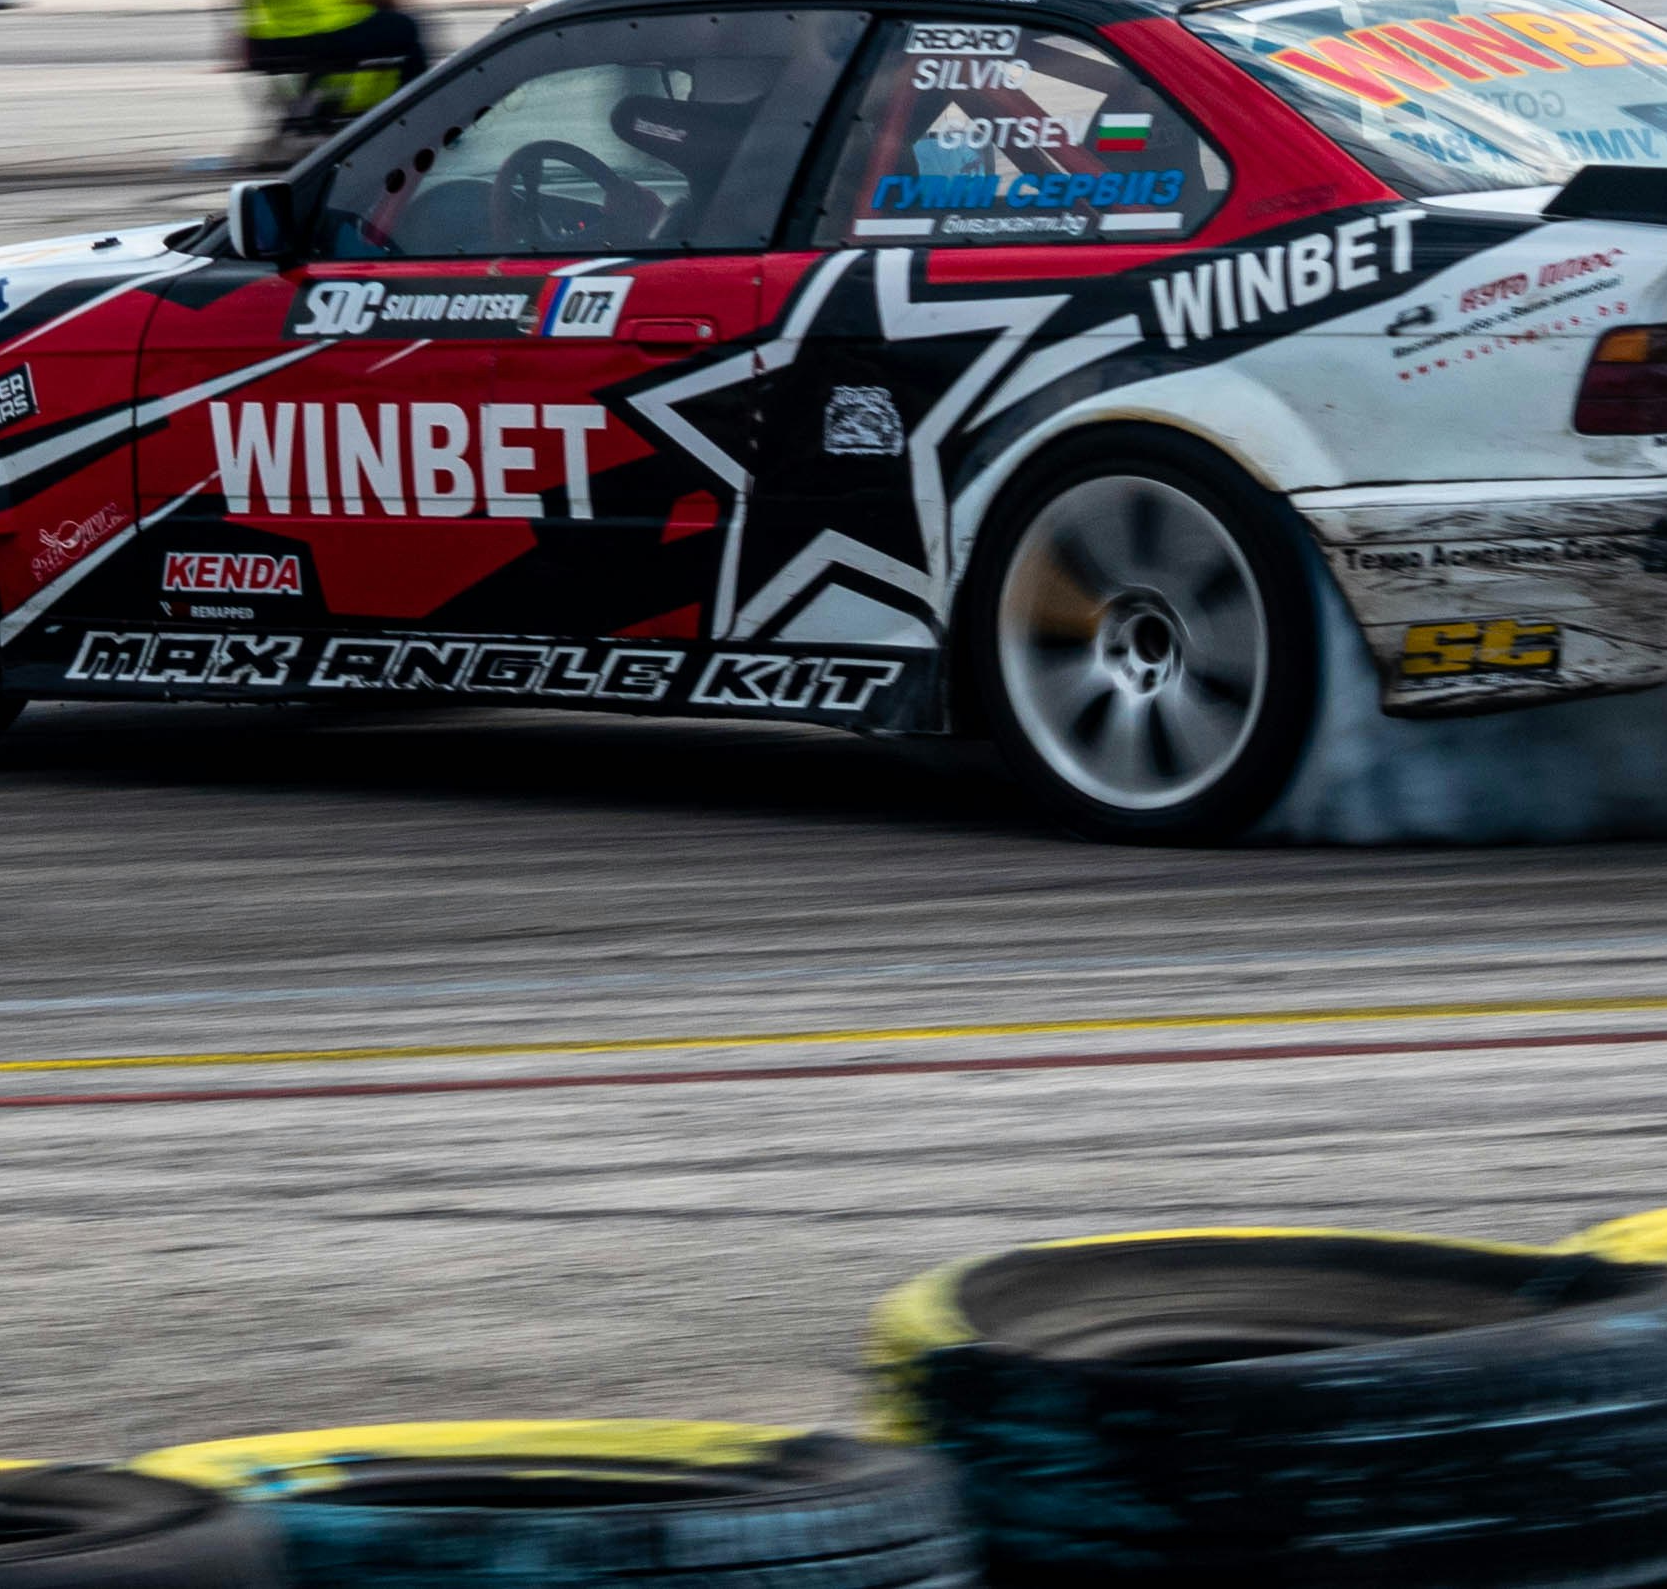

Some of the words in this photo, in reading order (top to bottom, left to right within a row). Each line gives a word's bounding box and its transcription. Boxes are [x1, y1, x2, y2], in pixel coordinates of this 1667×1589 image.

[914, 28, 1016, 51] RECARO
[911, 59, 1031, 92] SILVIO
[936, 115, 1087, 151] GOTSEV
[871, 173, 1001, 210] ГУМИ
[1005, 168, 1184, 210] СЕРВИЗ
[1150, 210, 1426, 350] WINBET
[381, 293, 449, 321] SILVIO
[446, 293, 530, 321] GOTSEV
[209, 401, 607, 520] WINBET
[162, 551, 303, 595] KENDA
[189, 604, 255, 620] REMAPPED
[65, 631, 302, 687] MAX
[309, 635, 677, 701] ANGLE
[689, 651, 905, 711] KIT
